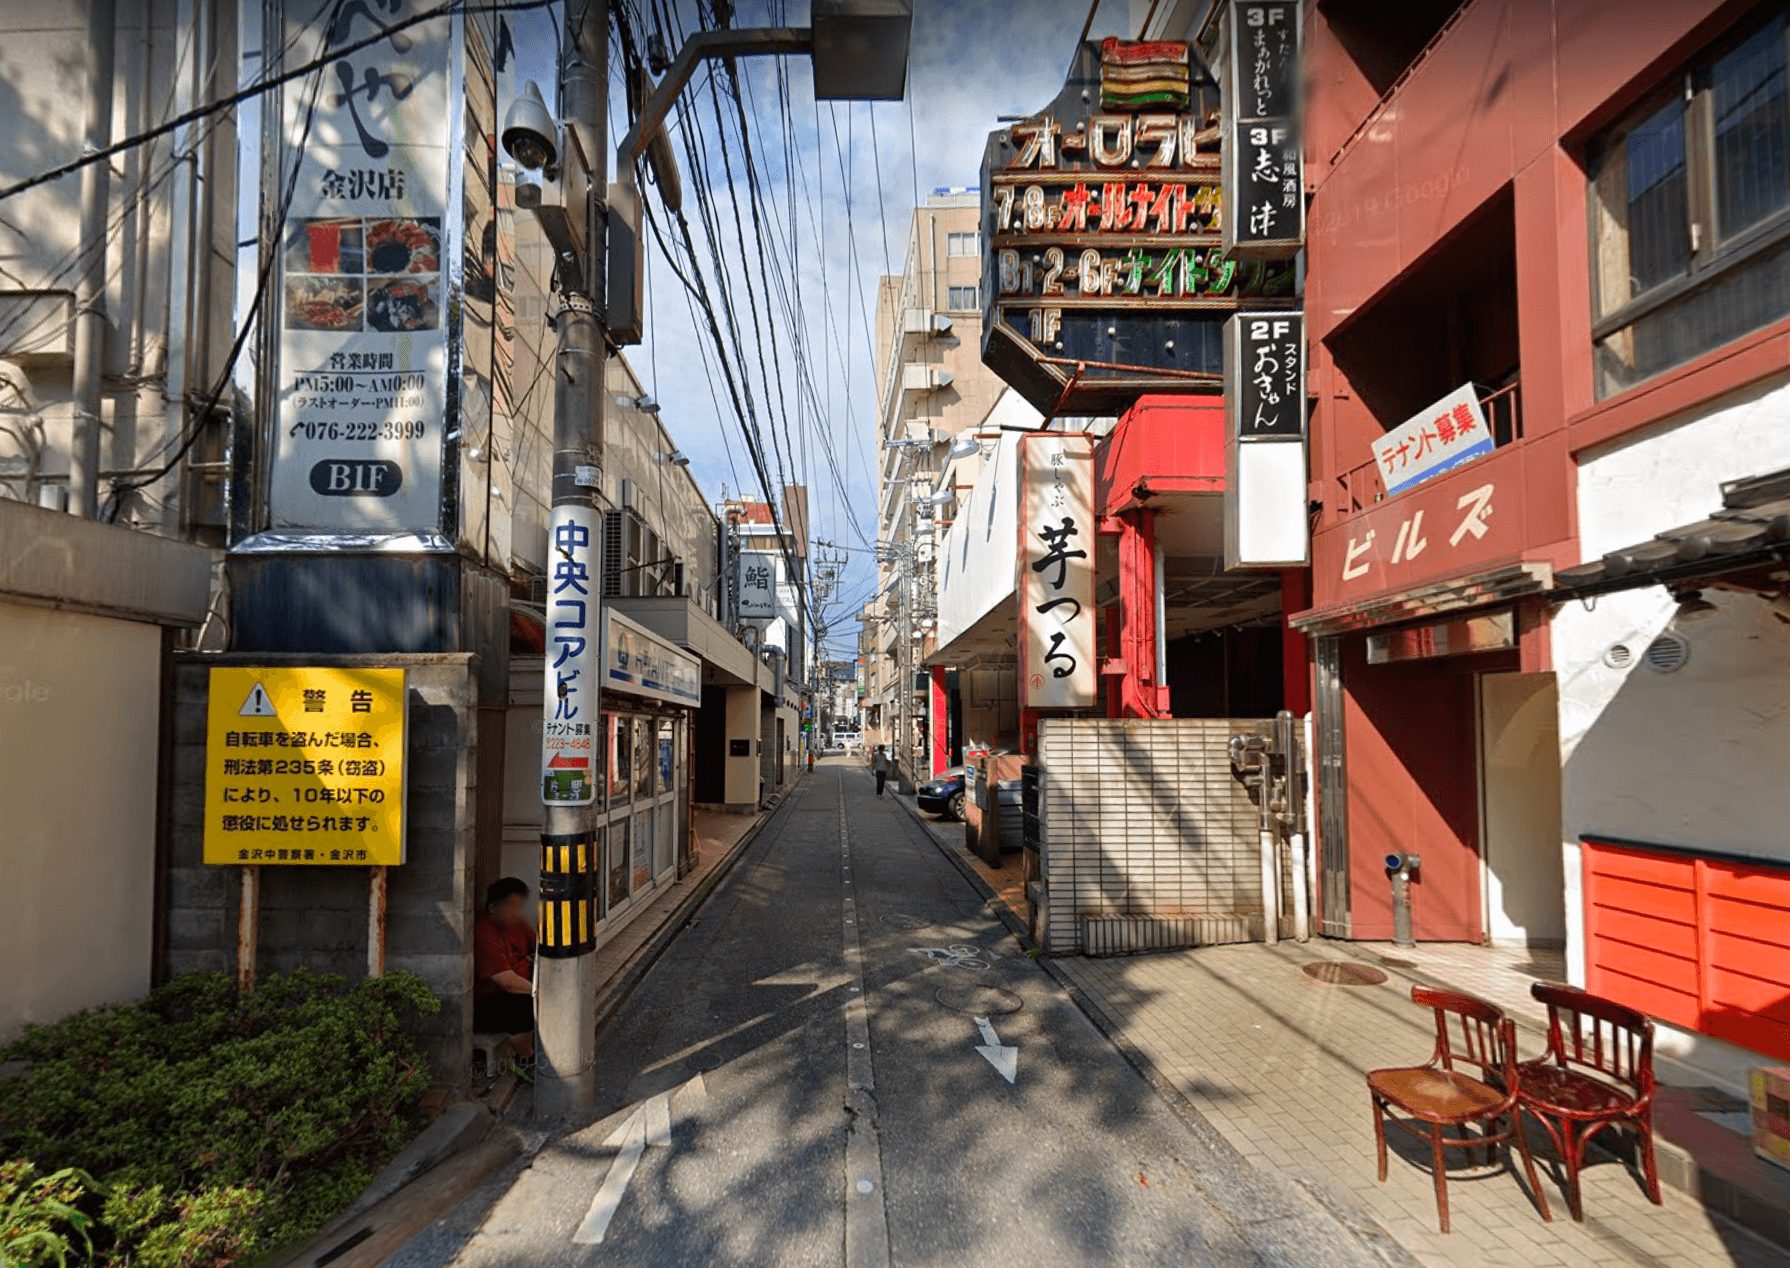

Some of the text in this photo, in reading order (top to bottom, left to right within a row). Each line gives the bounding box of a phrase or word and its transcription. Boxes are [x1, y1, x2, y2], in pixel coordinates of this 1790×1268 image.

[1247, 8, 1285, 26] 3F
[1250, 128, 1288, 145] 3F
[320, 169, 406, 200] 金沢店
[1251, 321, 1290, 340] 2F
[330, 352, 393, 370] 営業時間
[1284, 343, 1298, 395] スタンド
[304, 420, 425, 441] 076-222-3999
[1382, 403, 1478, 474] テナント募集
[327, 463, 389, 493] B1F
[1342, 484, 1495, 582] ビルズ
[1032, 516, 1088, 678] 芋つる
[552, 519, 590, 720] 中央コアビル
[225, 731, 380, 748] 自転車を盗んだ場合、
[221, 814, 378, 833] 懲役に処せられます。
